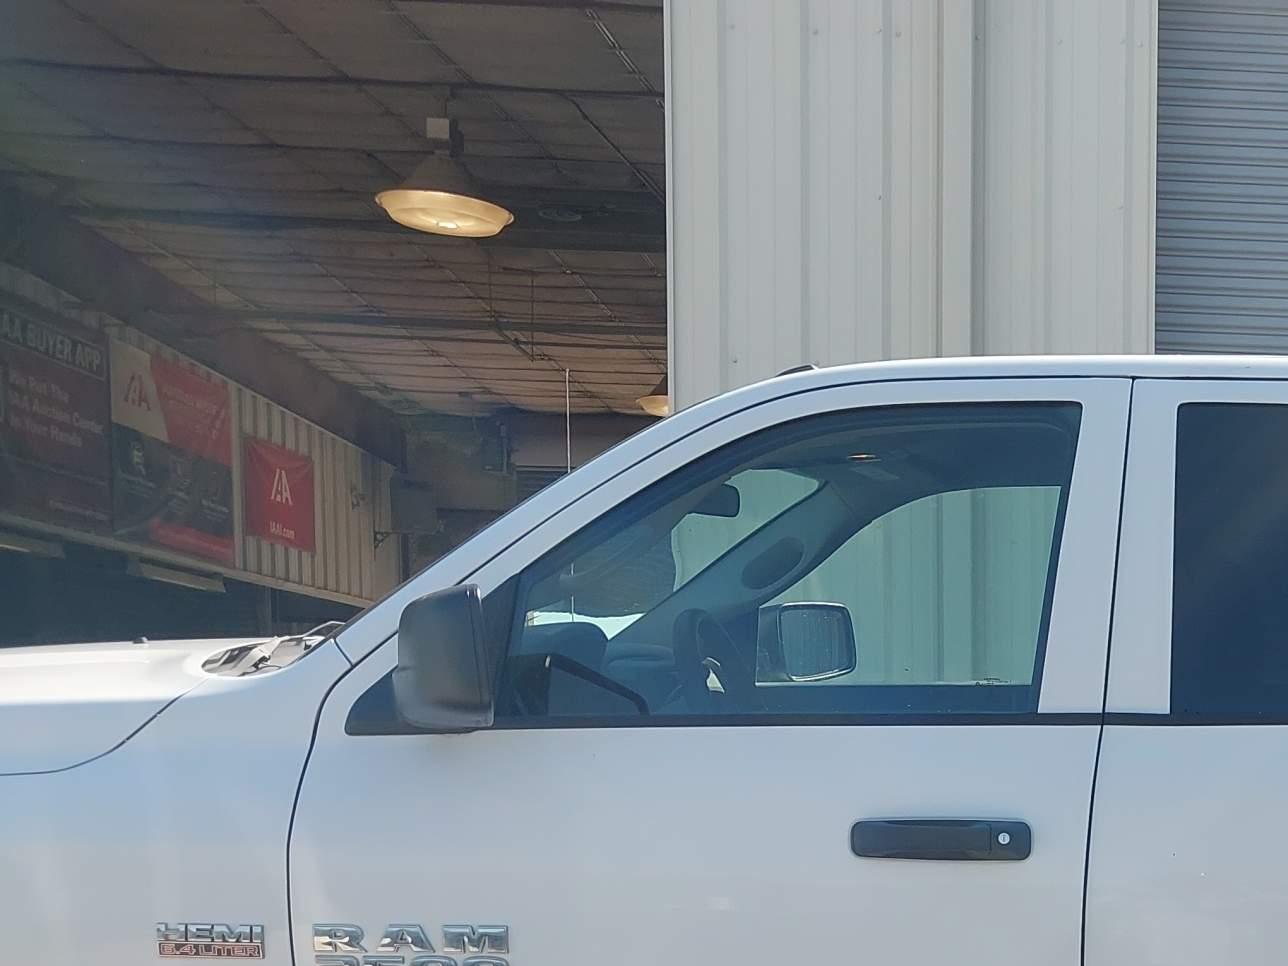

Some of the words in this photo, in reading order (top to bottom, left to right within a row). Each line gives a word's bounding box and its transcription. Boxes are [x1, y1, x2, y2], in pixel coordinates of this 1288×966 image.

[27, 322, 72, 362] BUYER
[75, 343, 101, 372] APP
[156, 922, 265, 943] HEMI
[312, 923, 510, 953] RAM
[160, 944, 196, 956] 6.4
[199, 944, 260, 957] LITER
